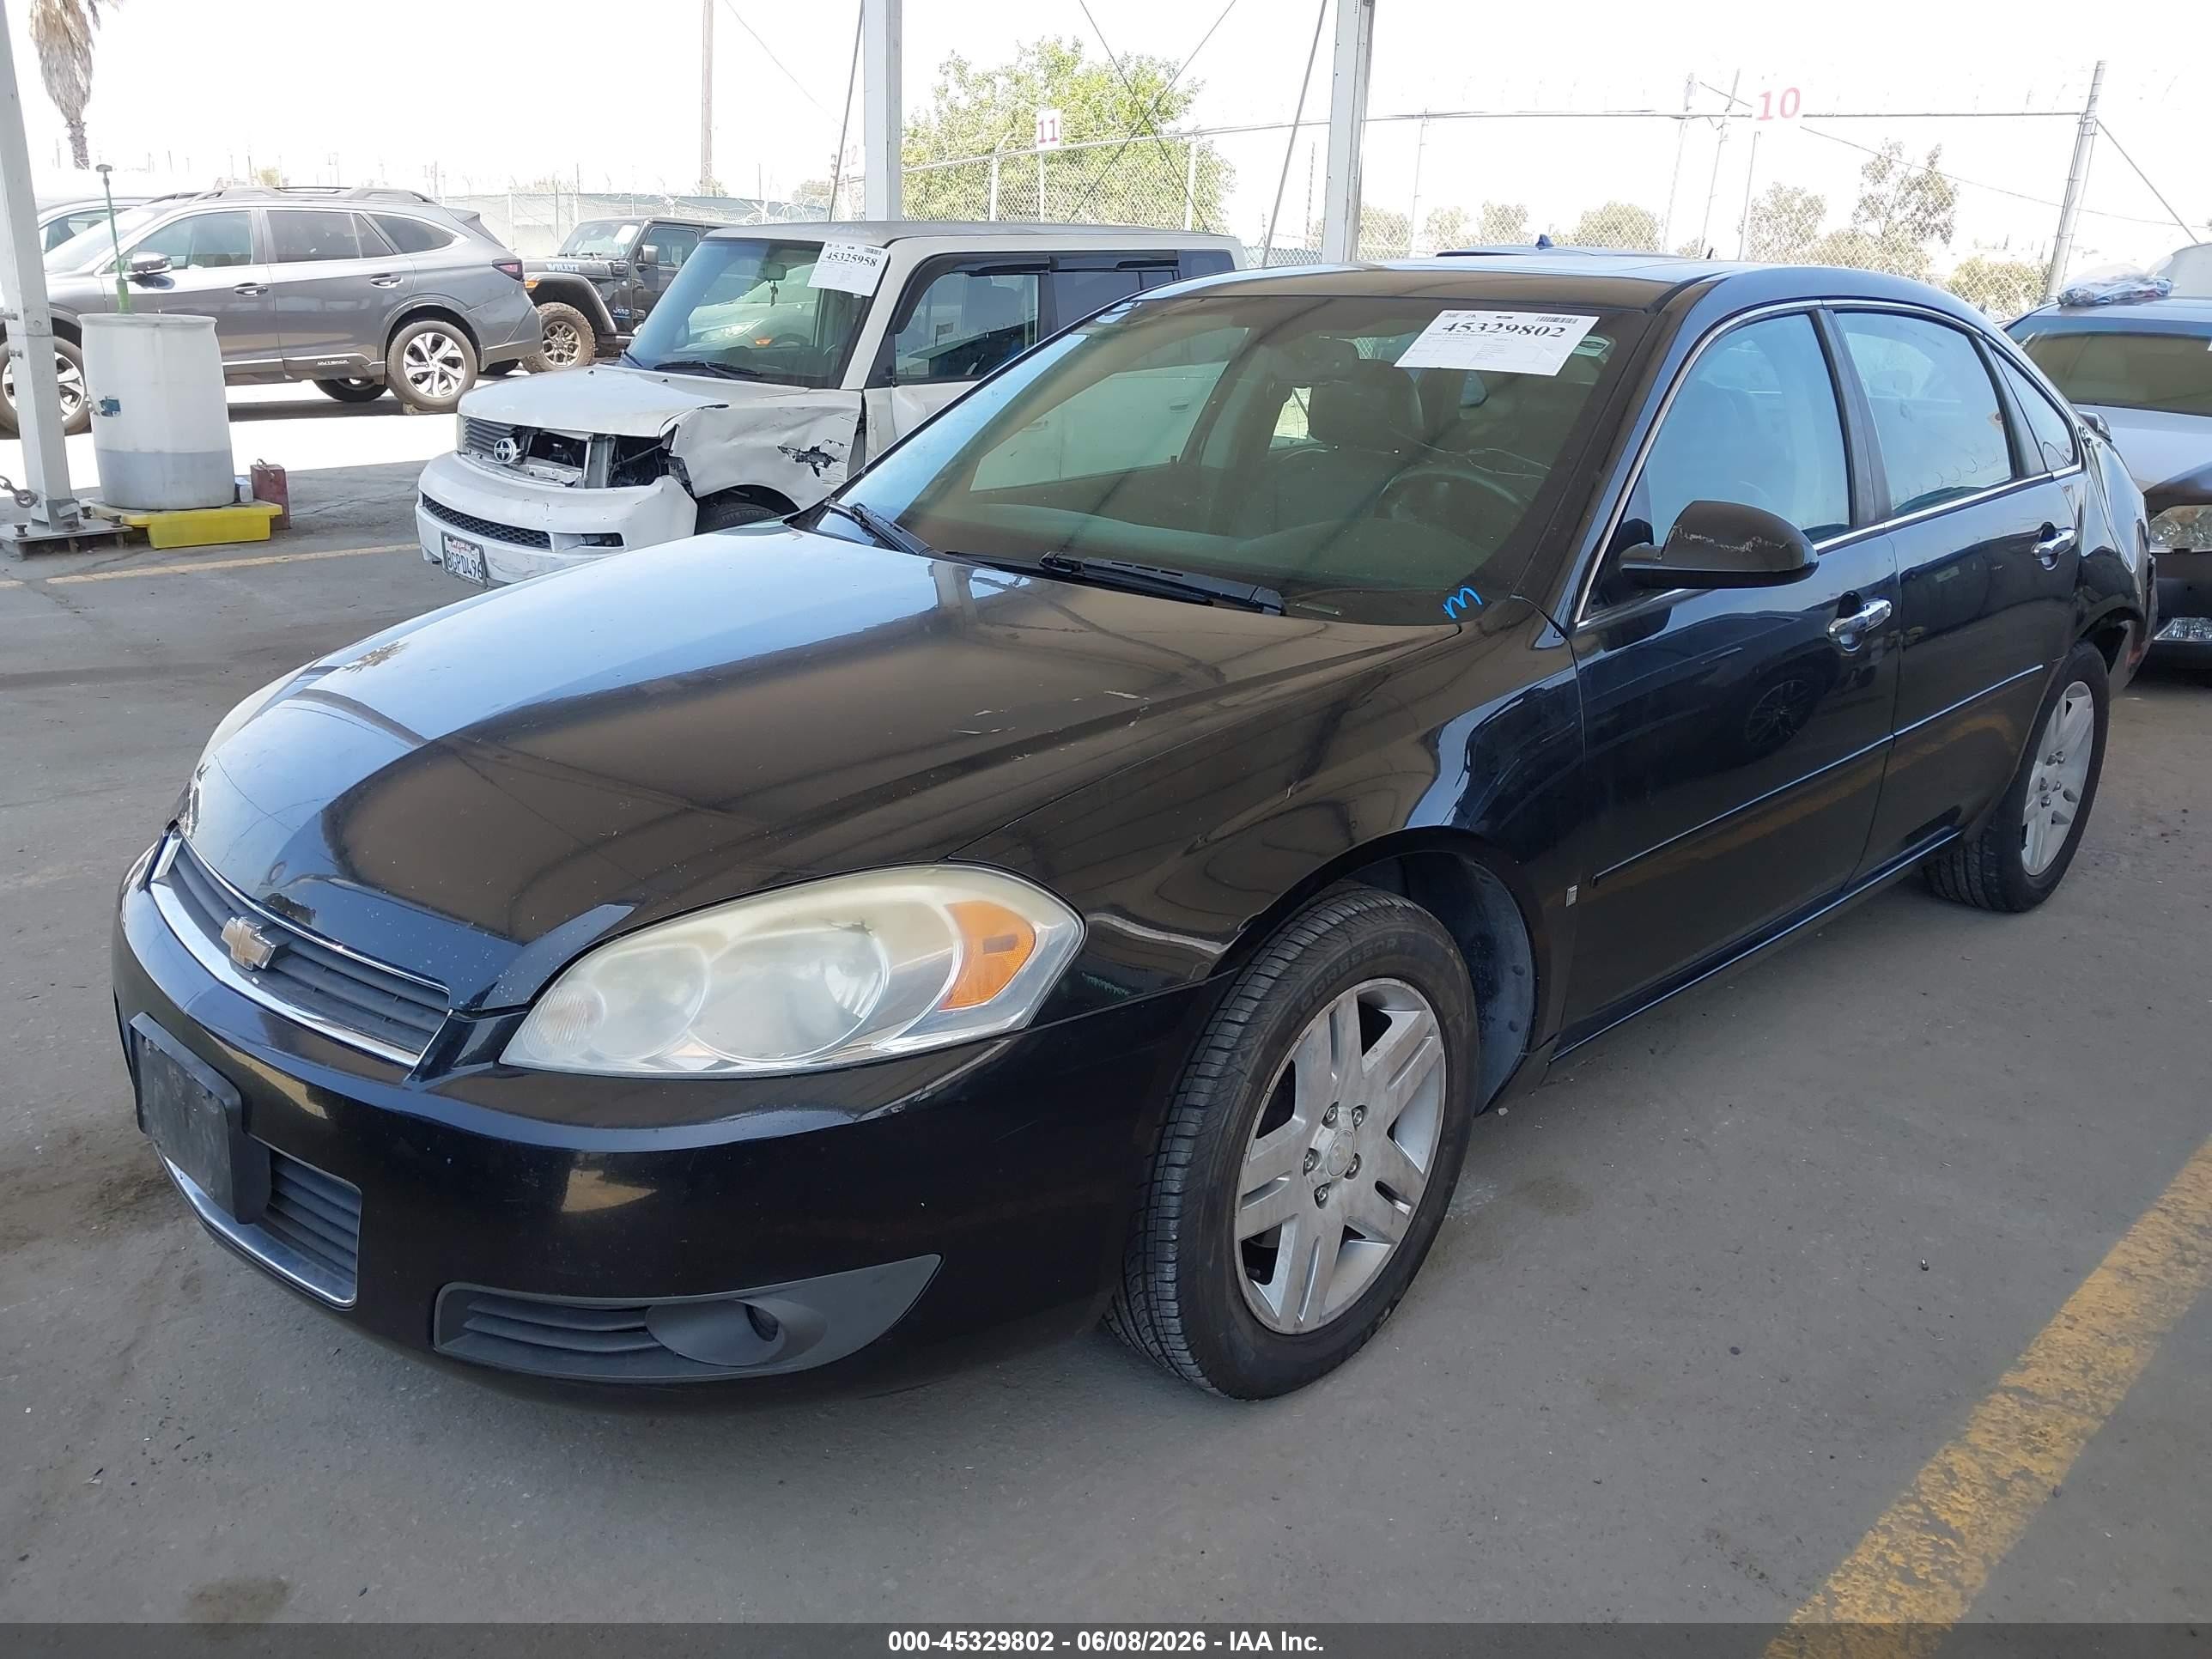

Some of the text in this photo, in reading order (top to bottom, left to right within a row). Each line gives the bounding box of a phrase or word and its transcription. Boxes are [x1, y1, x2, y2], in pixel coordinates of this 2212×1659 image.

[1757, 87, 1801, 121] 10
[1038, 117, 1058, 143] 11
[826, 251, 878, 267] 45325958
[1442, 321, 1566, 338] 45329802
